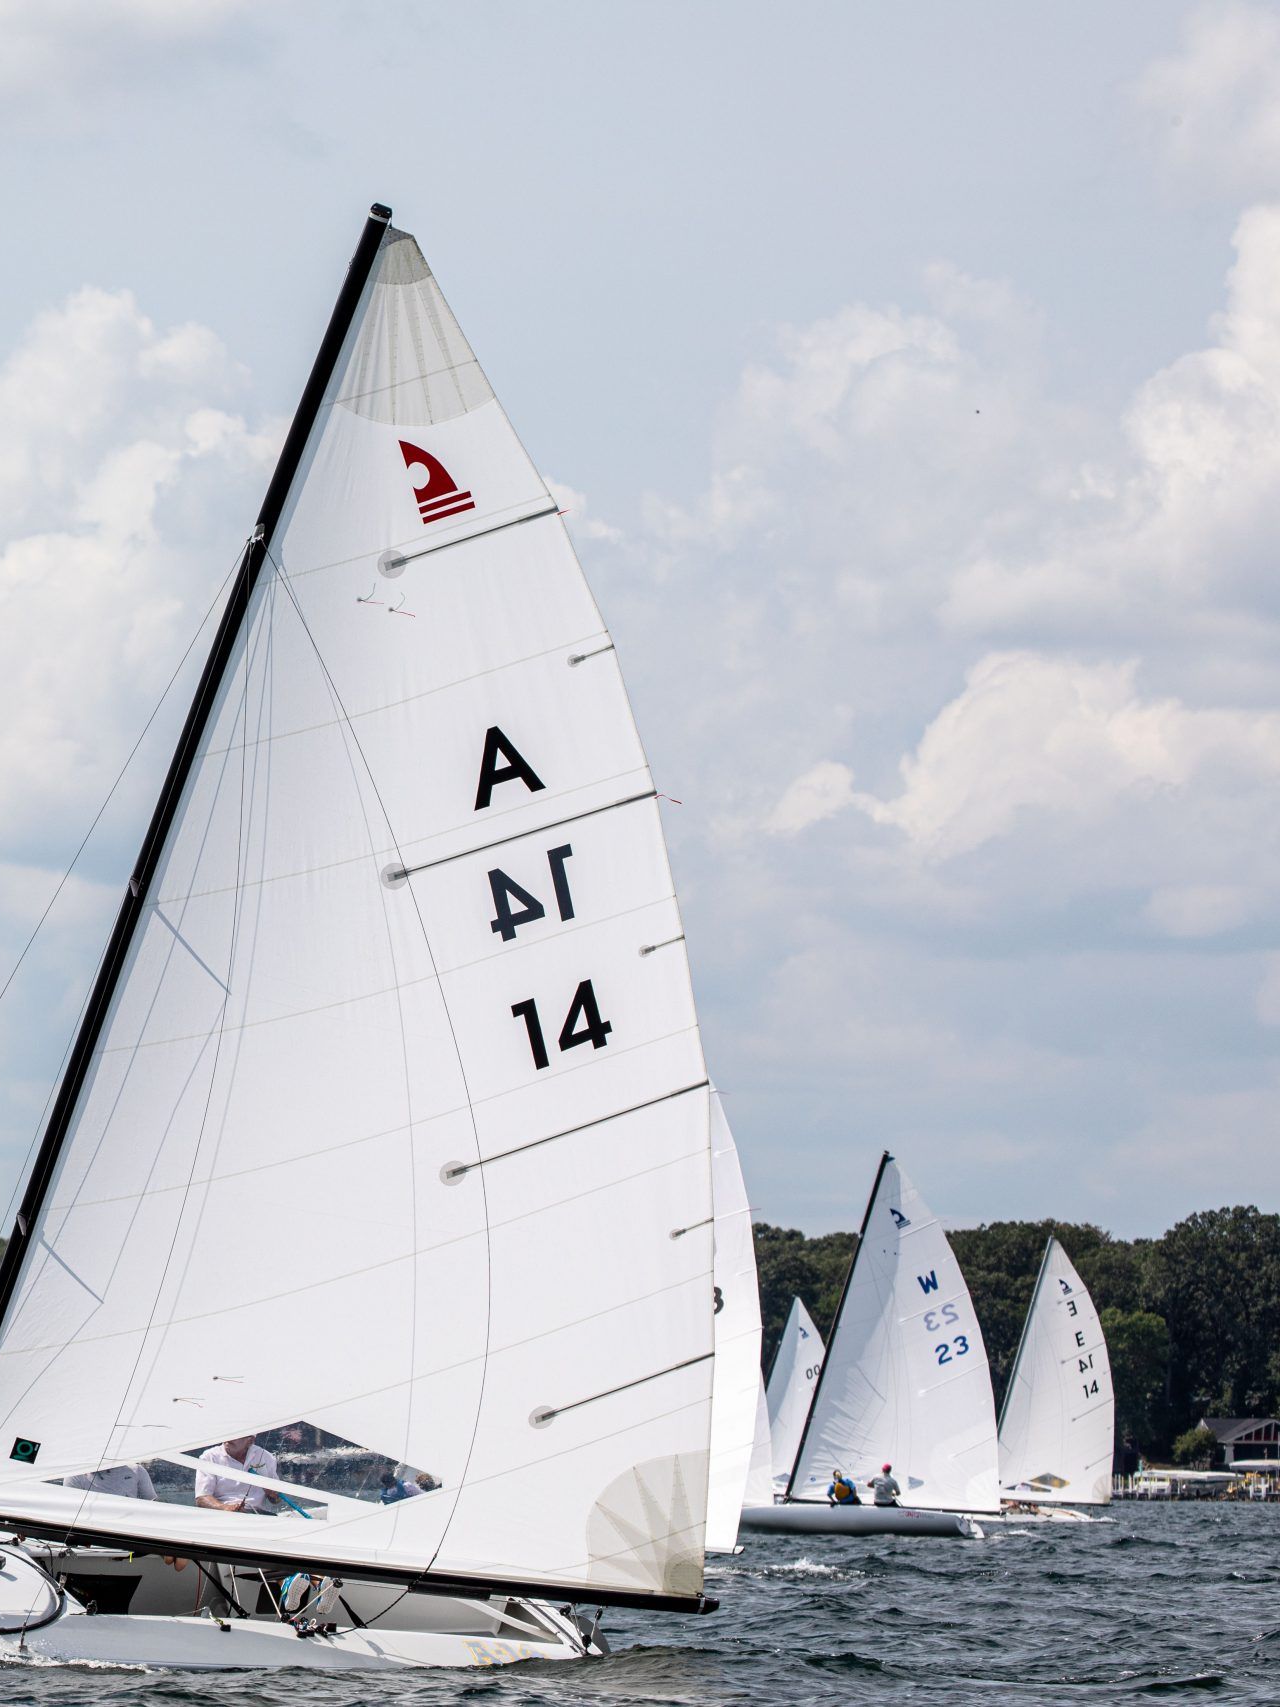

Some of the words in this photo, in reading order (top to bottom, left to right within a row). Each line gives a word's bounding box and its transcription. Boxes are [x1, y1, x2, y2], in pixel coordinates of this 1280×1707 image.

[475, 725, 546, 811] A
[511, 978, 613, 1070] 14
[917, 1270, 939, 1295] W
[934, 1335, 970, 1366] 23
[1075, 1331, 1085, 1347] E
[1083, 1379, 1099, 1399] 14
